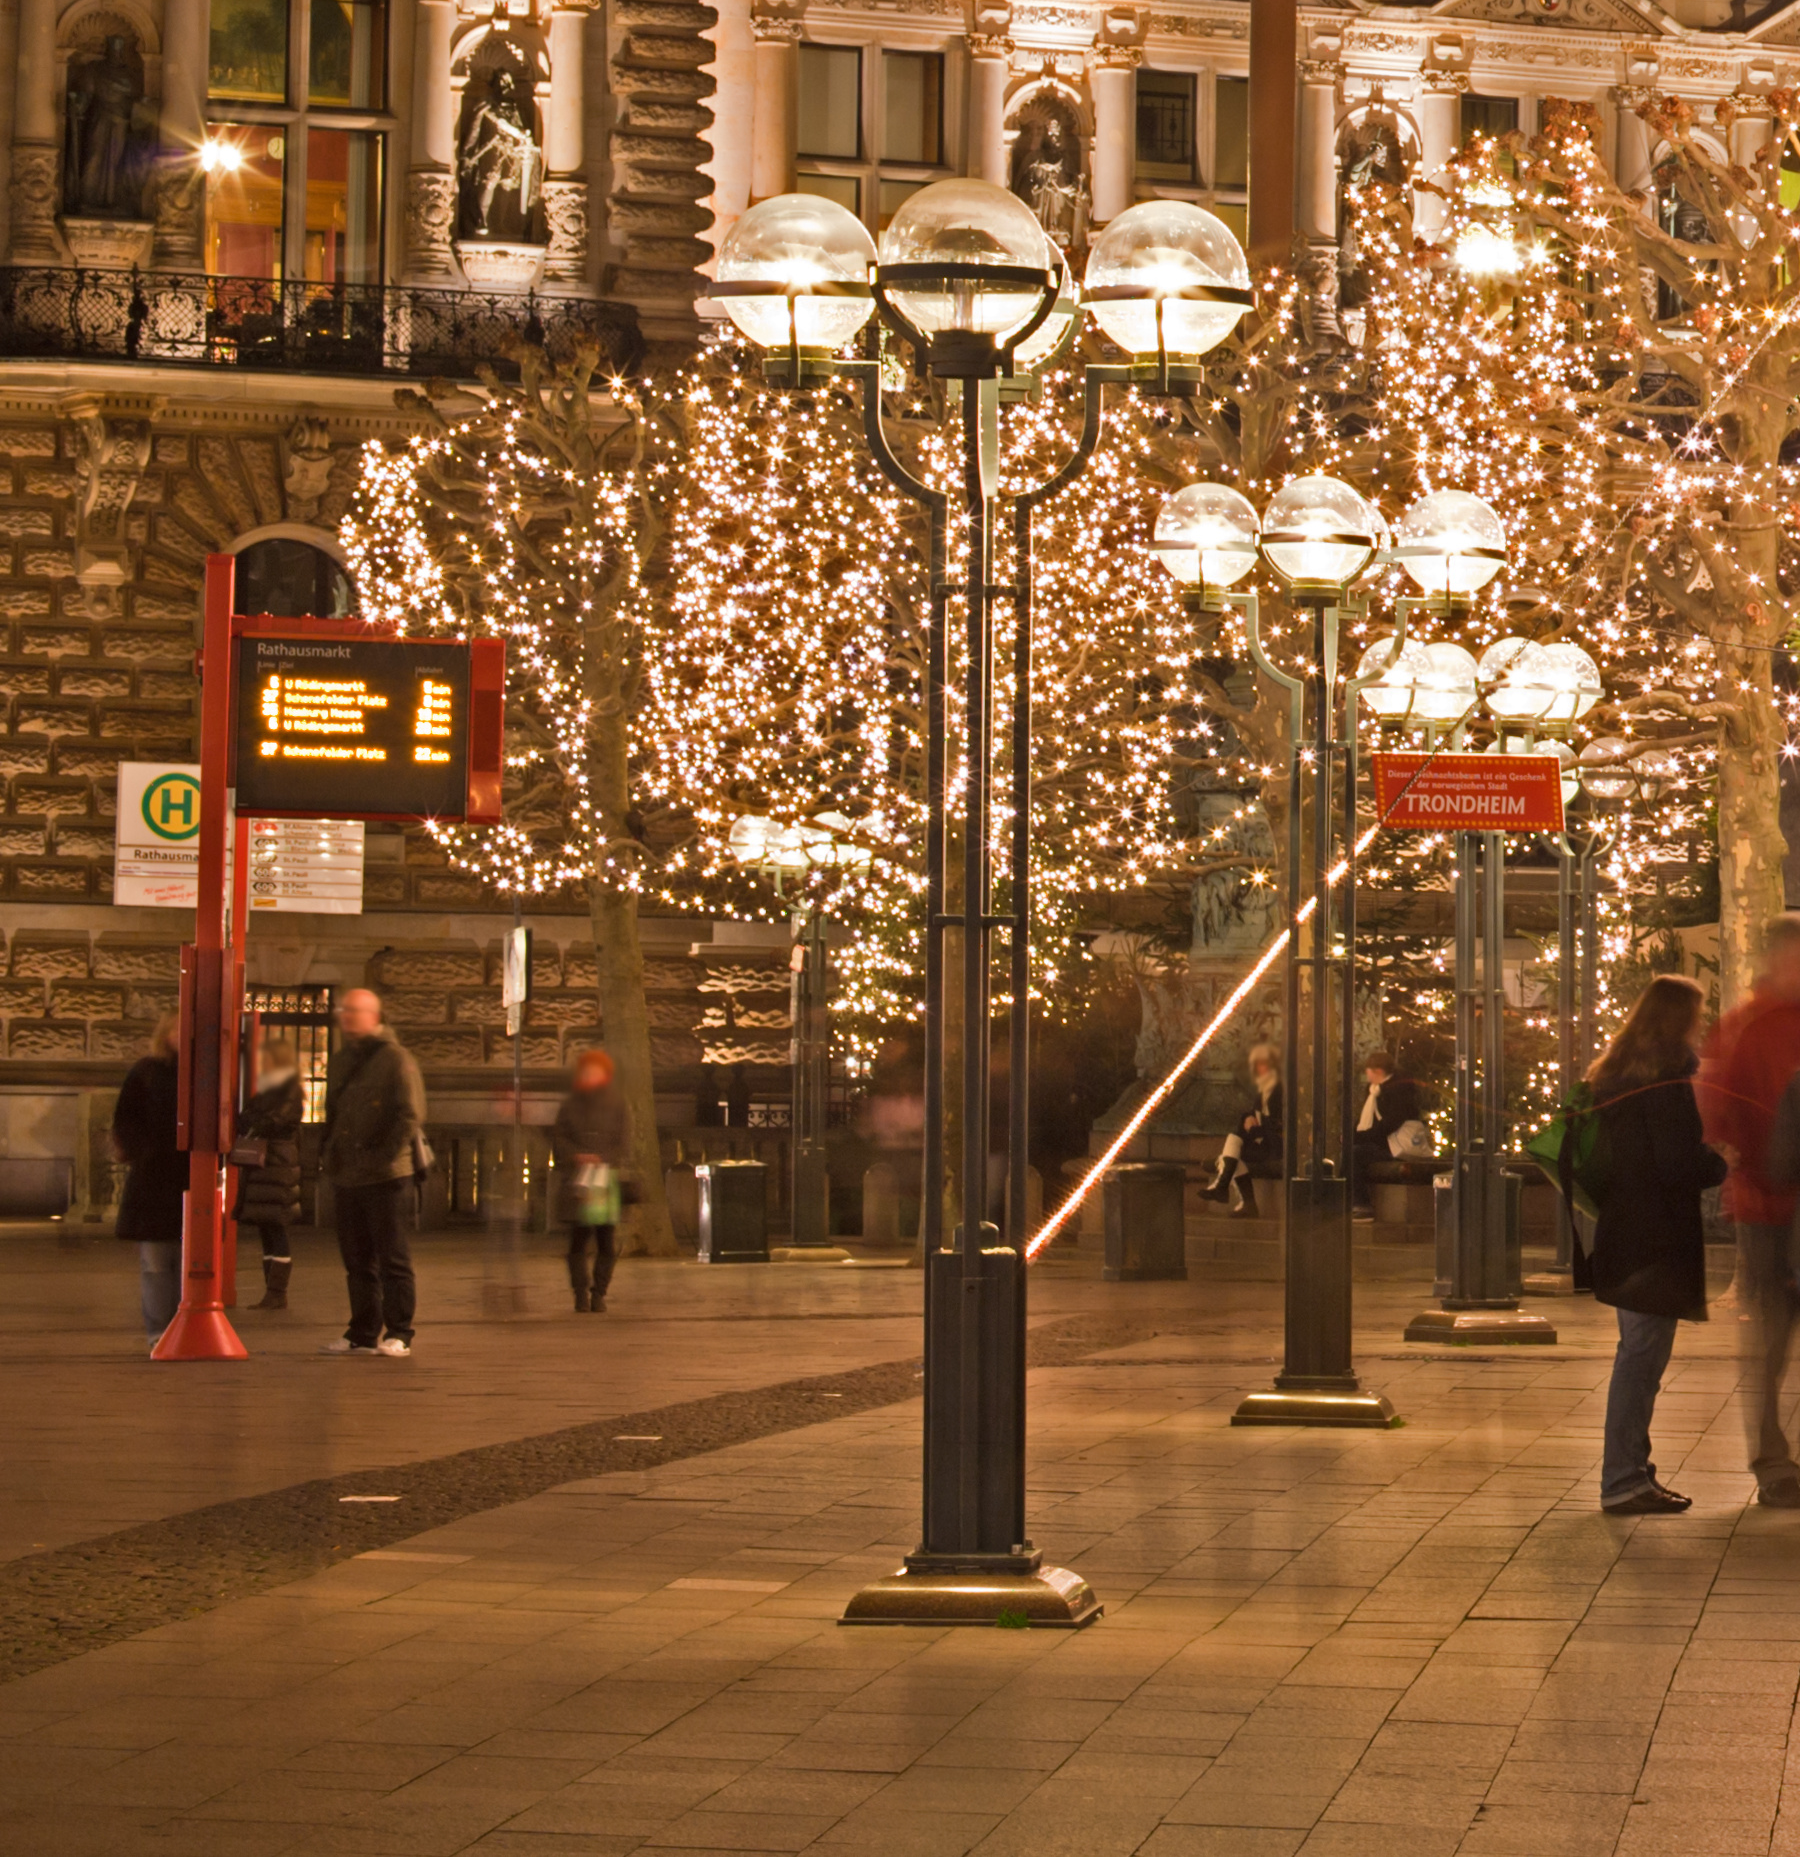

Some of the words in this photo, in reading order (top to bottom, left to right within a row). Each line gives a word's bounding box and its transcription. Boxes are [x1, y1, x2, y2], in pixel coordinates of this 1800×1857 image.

[257, 643, 351, 659] Rathausmarkt
[1388, 769, 1412, 778] Dieser
[1414, 770, 1481, 780] eihnachtsbaum
[1483, 771, 1493, 781] ist
[1494, 772, 1507, 780] ein
[1508, 772, 1547, 782] Geschenk
[1417, 781, 1430, 789] der
[1431, 781, 1485, 791] norwegischen
[1487, 782, 1508, 791] Stadt
[160, 788, 193, 825] H
[1404, 793, 1525, 815] TRONDHEIM
[134, 849, 199, 862] Rathausma
